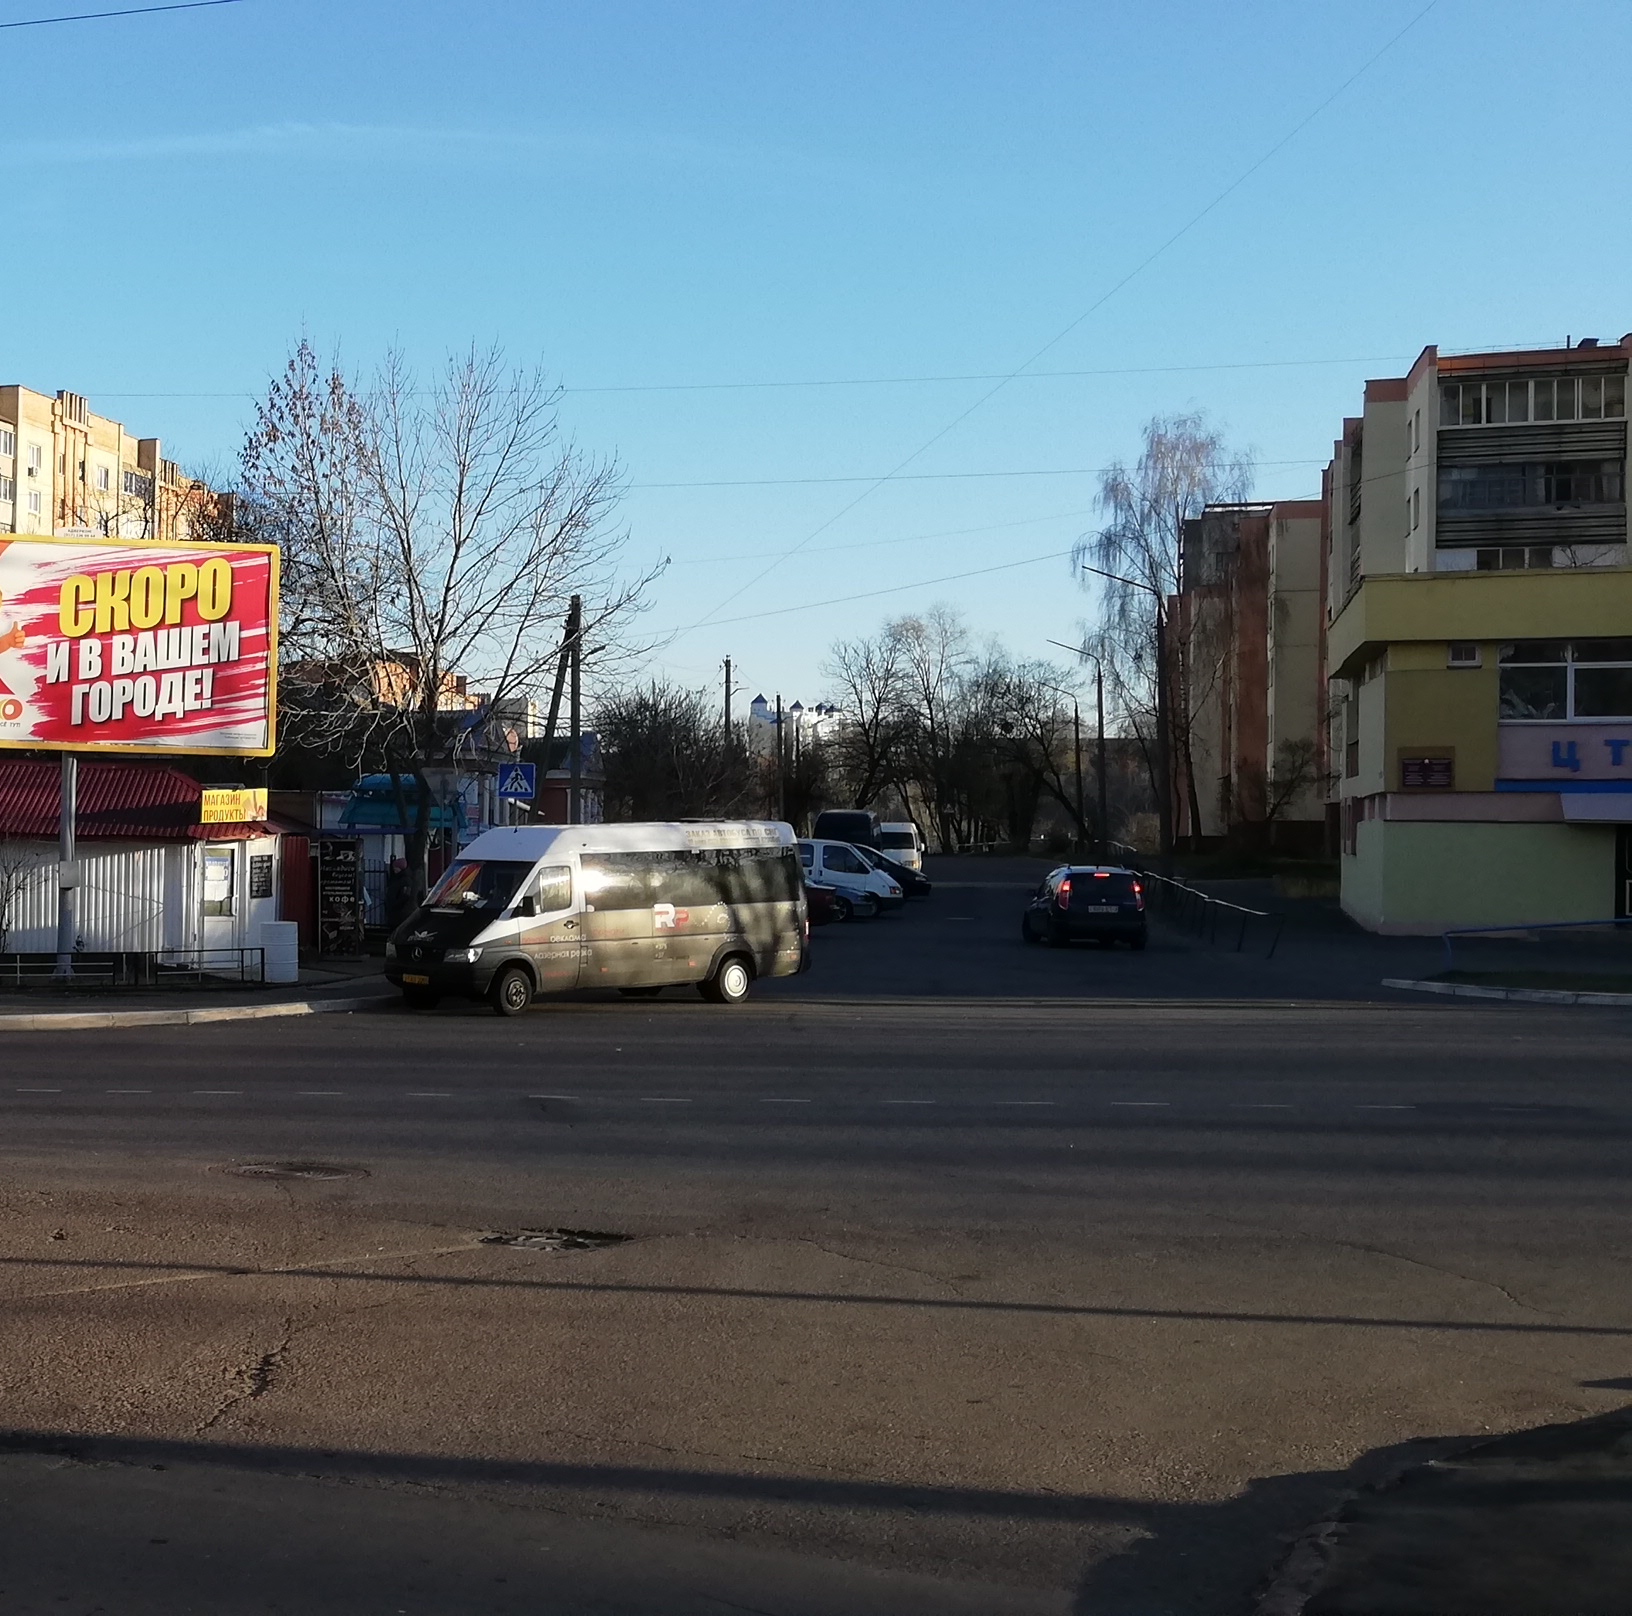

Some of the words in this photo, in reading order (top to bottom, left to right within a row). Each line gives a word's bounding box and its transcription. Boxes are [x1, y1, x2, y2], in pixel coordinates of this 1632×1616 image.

[58, 558, 232, 638] СКОРО
[46, 641, 70, 684] И
[78, 638, 102, 680] В
[111, 621, 240, 676] ВАШЕМ
[71, 668, 214, 725] ГОРОДЕ!
[204, 794, 241, 806] МАГАЗИН
[204, 809, 246, 821] ПРОДУКТЫ
